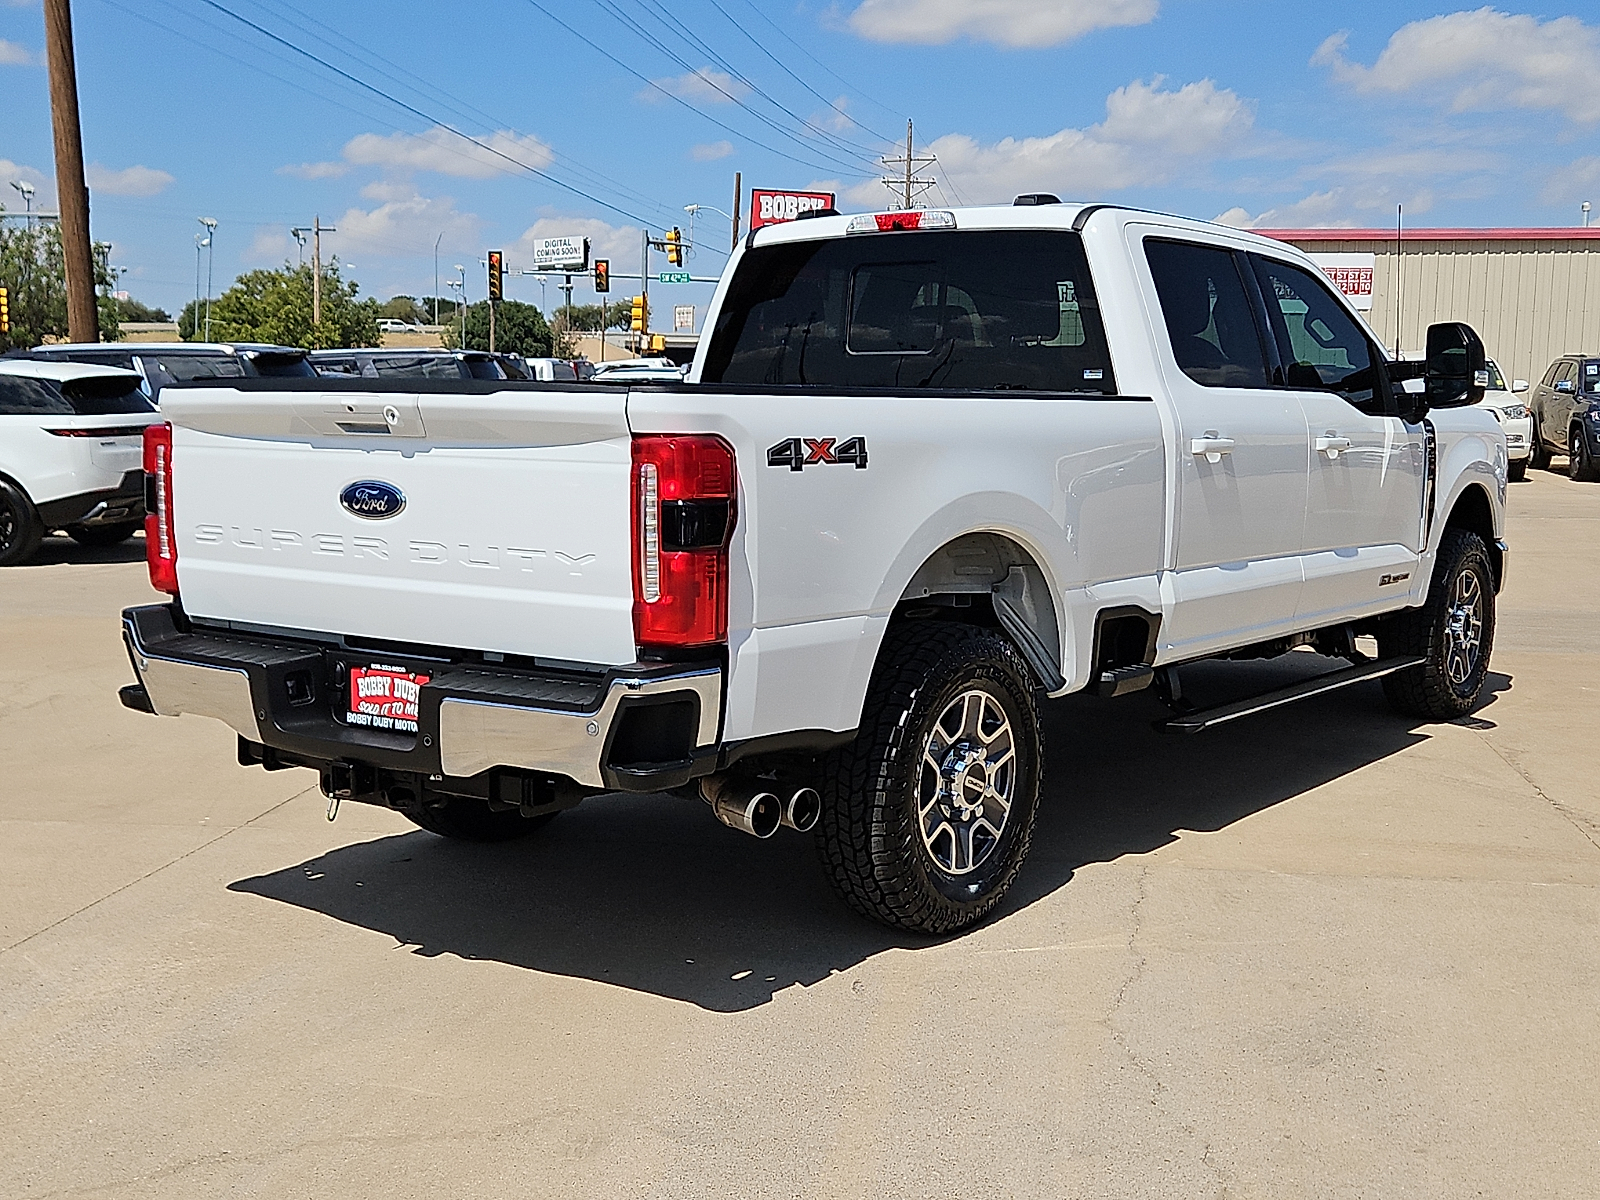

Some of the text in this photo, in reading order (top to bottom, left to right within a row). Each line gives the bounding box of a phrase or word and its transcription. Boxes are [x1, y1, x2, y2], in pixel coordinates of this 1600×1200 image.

[760, 195, 825, 219] BOBBY
[536, 246, 581, 257] COMING SOON!
[545, 239, 571, 248] DIGITAL
[1361, 282, 1371, 291] 10
[352, 487, 389, 511] Ford
[195, 522, 596, 576] SUPER DUTY
[356, 675, 392, 698] BOBBY
[357, 701, 381, 716] SOLD
[381, 703, 391, 715] IT
[391, 701, 405, 715] TO
[346, 711, 372, 726] BOBBY
[372, 714, 394, 729] DUBY
